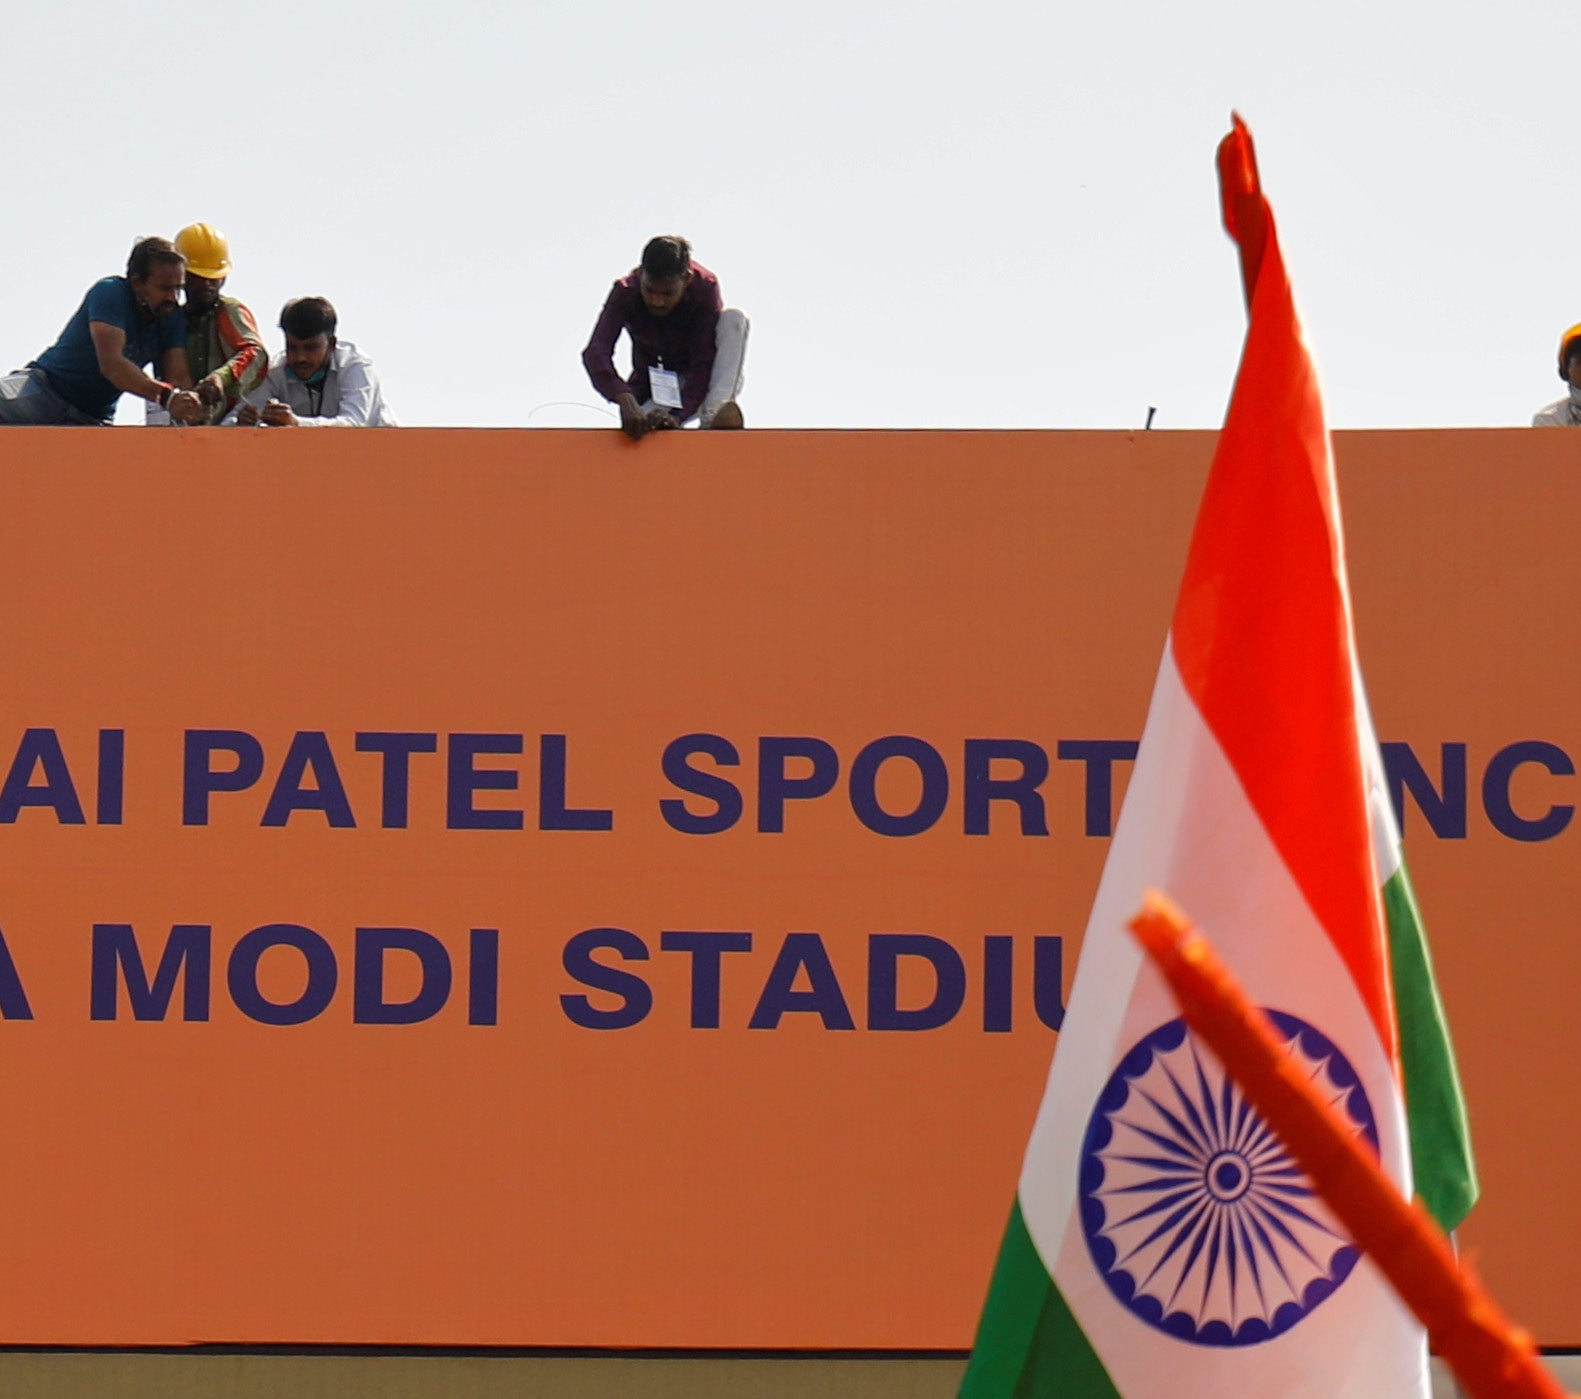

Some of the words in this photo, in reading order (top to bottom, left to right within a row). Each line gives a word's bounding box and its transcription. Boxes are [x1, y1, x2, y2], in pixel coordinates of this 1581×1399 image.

[182, 729, 614, 833] PATEL
[660, 733, 1141, 839] SPORT
[90, 923, 500, 1028] MODI
